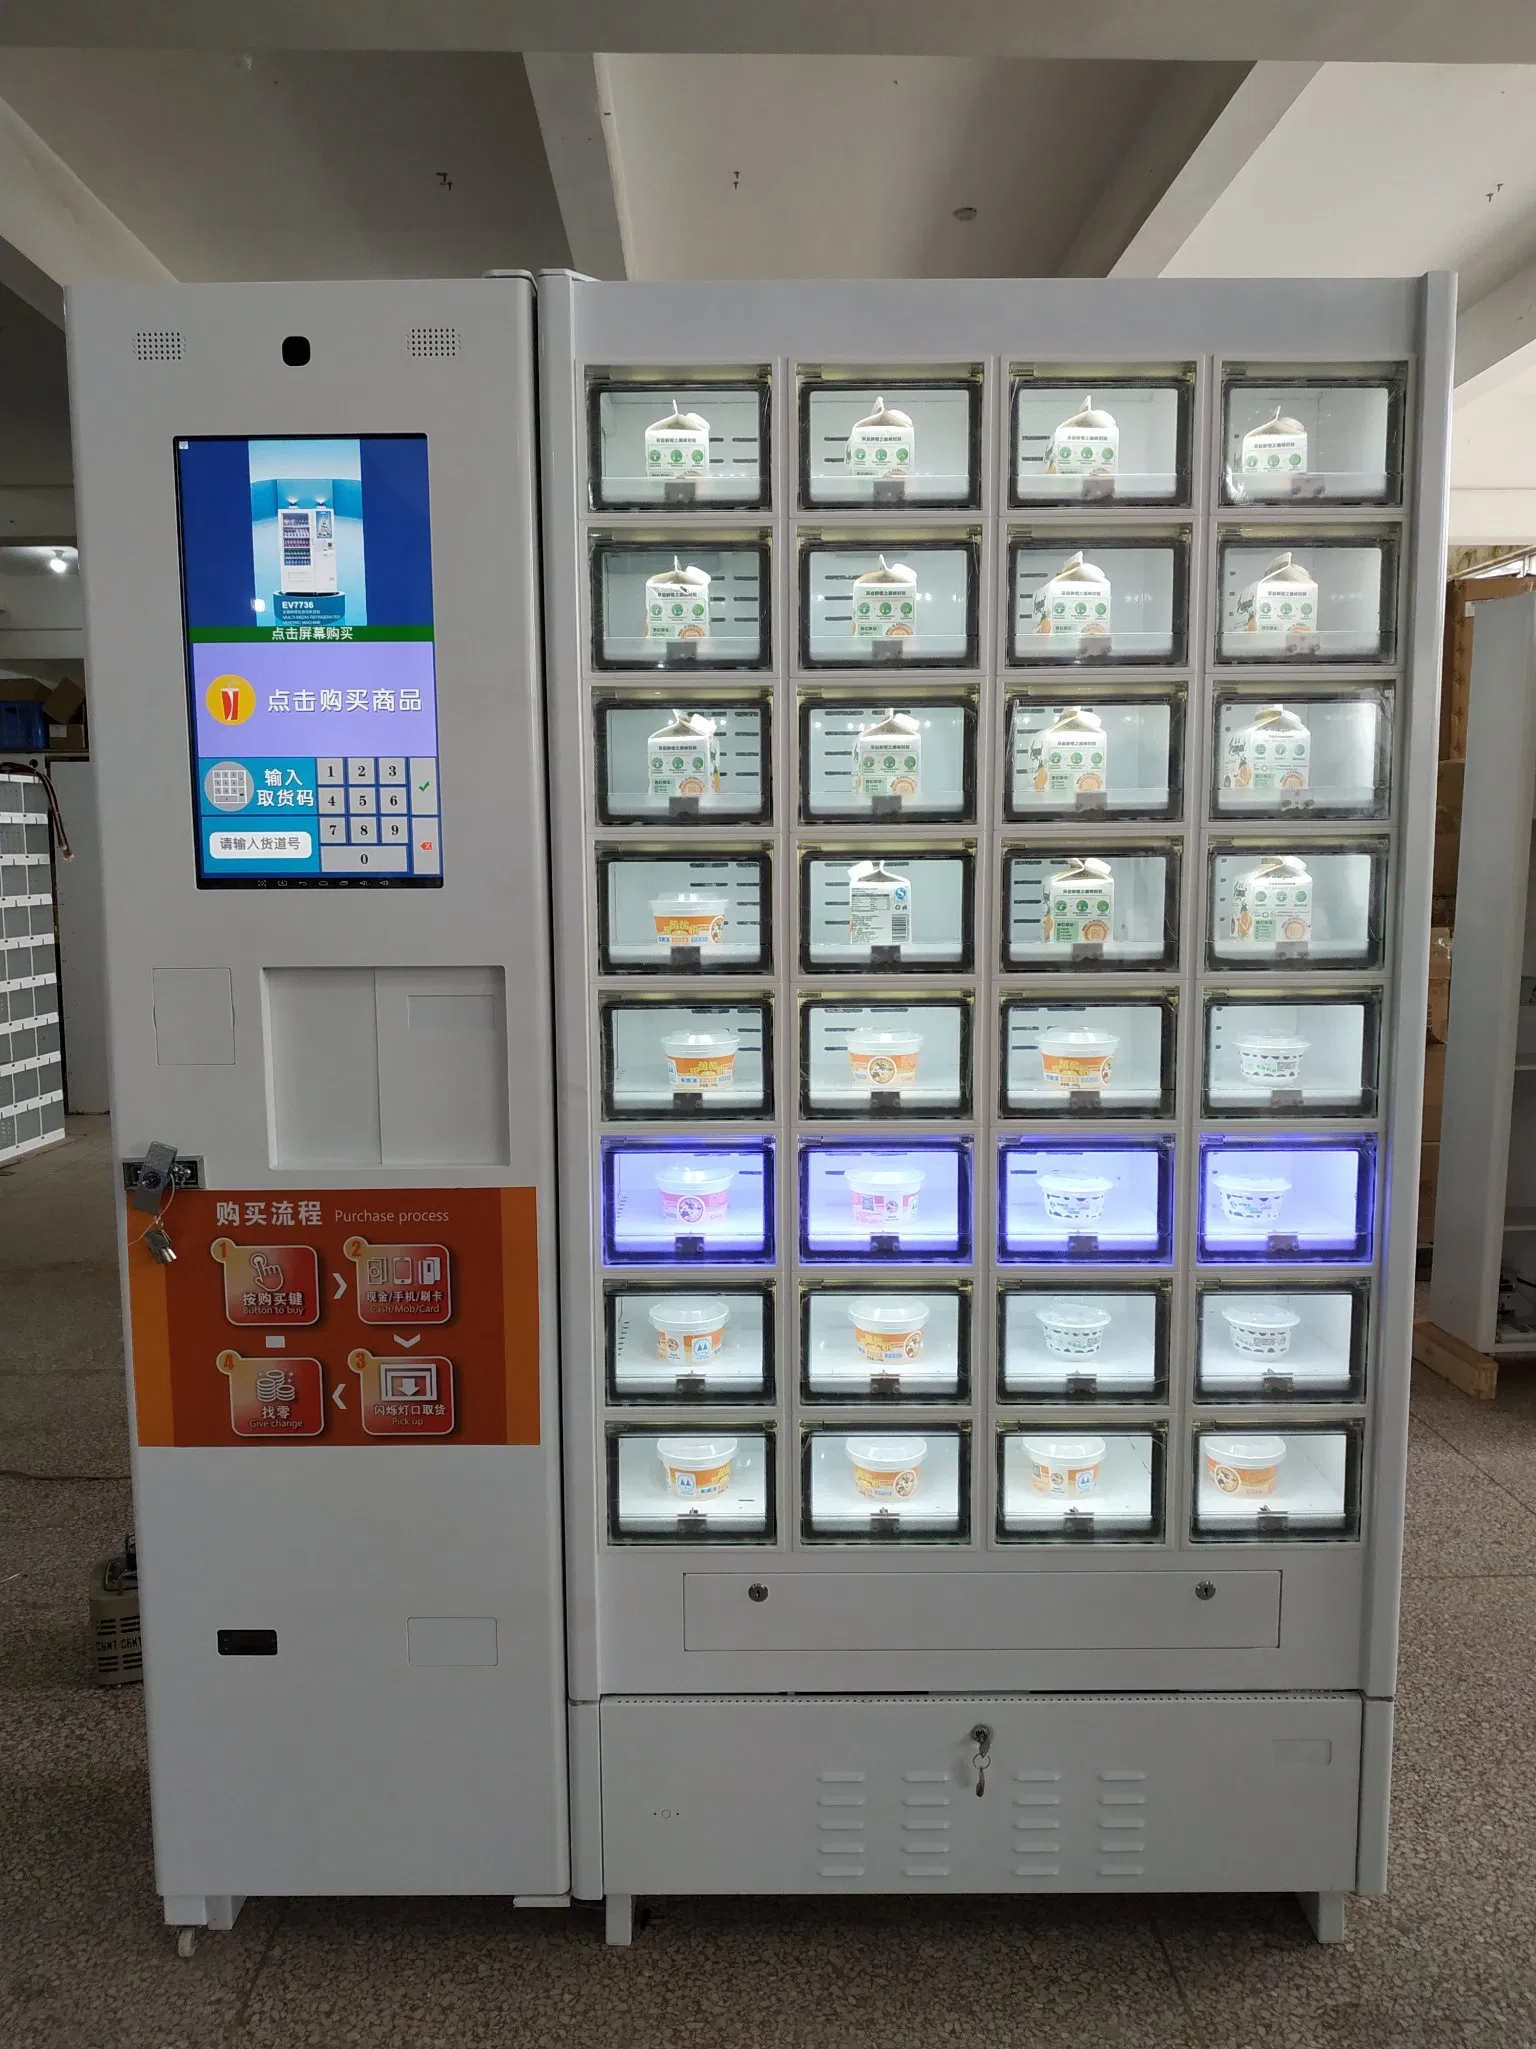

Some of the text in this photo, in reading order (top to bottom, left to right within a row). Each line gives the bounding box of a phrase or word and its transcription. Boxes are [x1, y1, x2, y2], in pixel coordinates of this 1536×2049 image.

[282, 601, 314, 609] EV7736
[272, 627, 353, 640] 点击屏幕购买
[268, 688, 422, 712] 点击购买商品
[264, 769, 303, 787] 输入
[328, 765, 396, 777] 1 2 3
[257, 789, 314, 807] 取货码
[328, 795, 397, 806] 4 5 6
[329, 825, 399, 835] 7 8 9
[220, 837, 300, 851] 请输入货道号
[360, 854, 368, 864] 0
[216, 1201, 323, 1226] 购买流程
[335, 1209, 449, 1224] Purchase process
[219, 1243, 228, 1258] 1
[352, 1241, 361, 1256] 2
[243, 1292, 303, 1306] 按购买键
[367, 1291, 442, 1302] 现金/手机/刷卡
[243, 1306, 304, 1315] Button to buy
[370, 1304, 439, 1313] Cash/Mob/Card
[224, 1354, 234, 1370] 4
[355, 1353, 365, 1369] 3
[262, 1405, 290, 1419] 找零
[374, 1405, 446, 1416] 闪烁灯口取货
[250, 1419, 303, 1429] Give change
